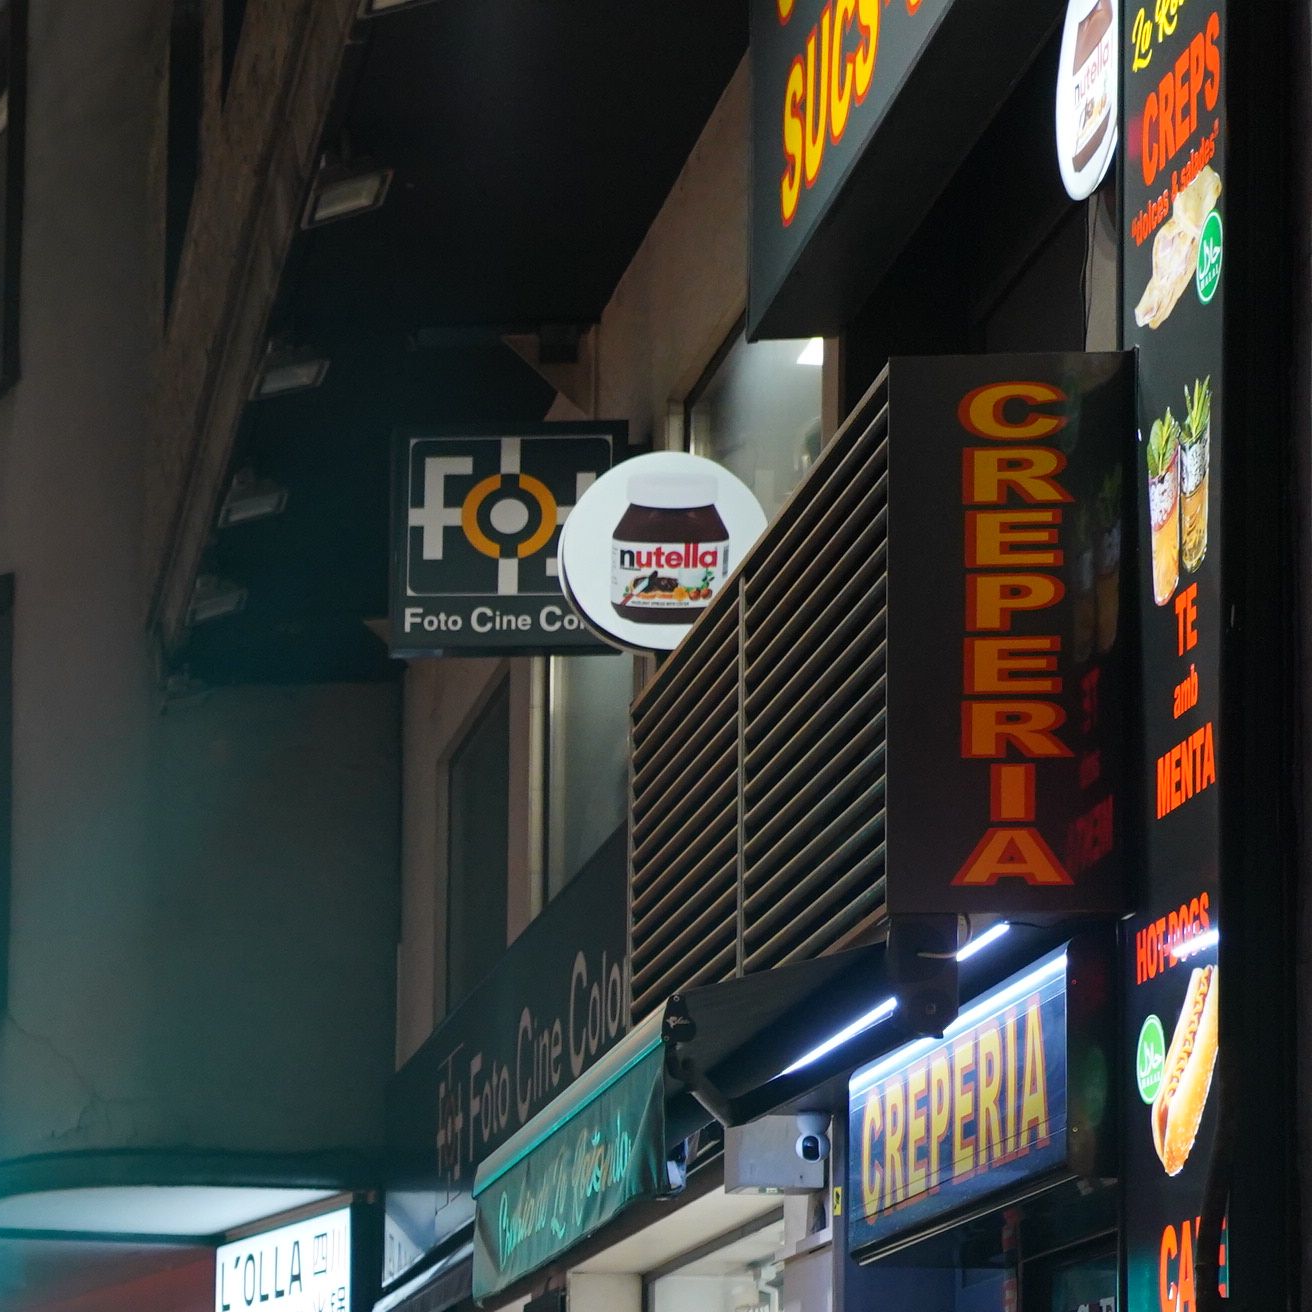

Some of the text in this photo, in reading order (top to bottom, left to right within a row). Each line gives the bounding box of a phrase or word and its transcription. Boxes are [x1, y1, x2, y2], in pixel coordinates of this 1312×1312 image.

[781, 0, 880, 227] SUCS
[1075, 41, 1110, 106] nutella
[1142, 11, 1221, 187] CREPS
[620, 542, 718, 569] nutella
[404, 607, 463, 633] Foto
[470, 606, 532, 633] Cine
[950, 381, 1075, 886] CREPERIA
[1174, 582, 1198, 657] TE
[1173, 663, 1199, 720] amb
[1156, 721, 1216, 820] MENTA
[1135, 891, 1211, 986] HOT-DOGS
[469, 1051, 510, 1163] Foto
[516, 1007, 563, 1124] Cine
[862, 992, 1050, 1225] CREPERIA
[221, 1240, 303, 1312] L'OLLA
